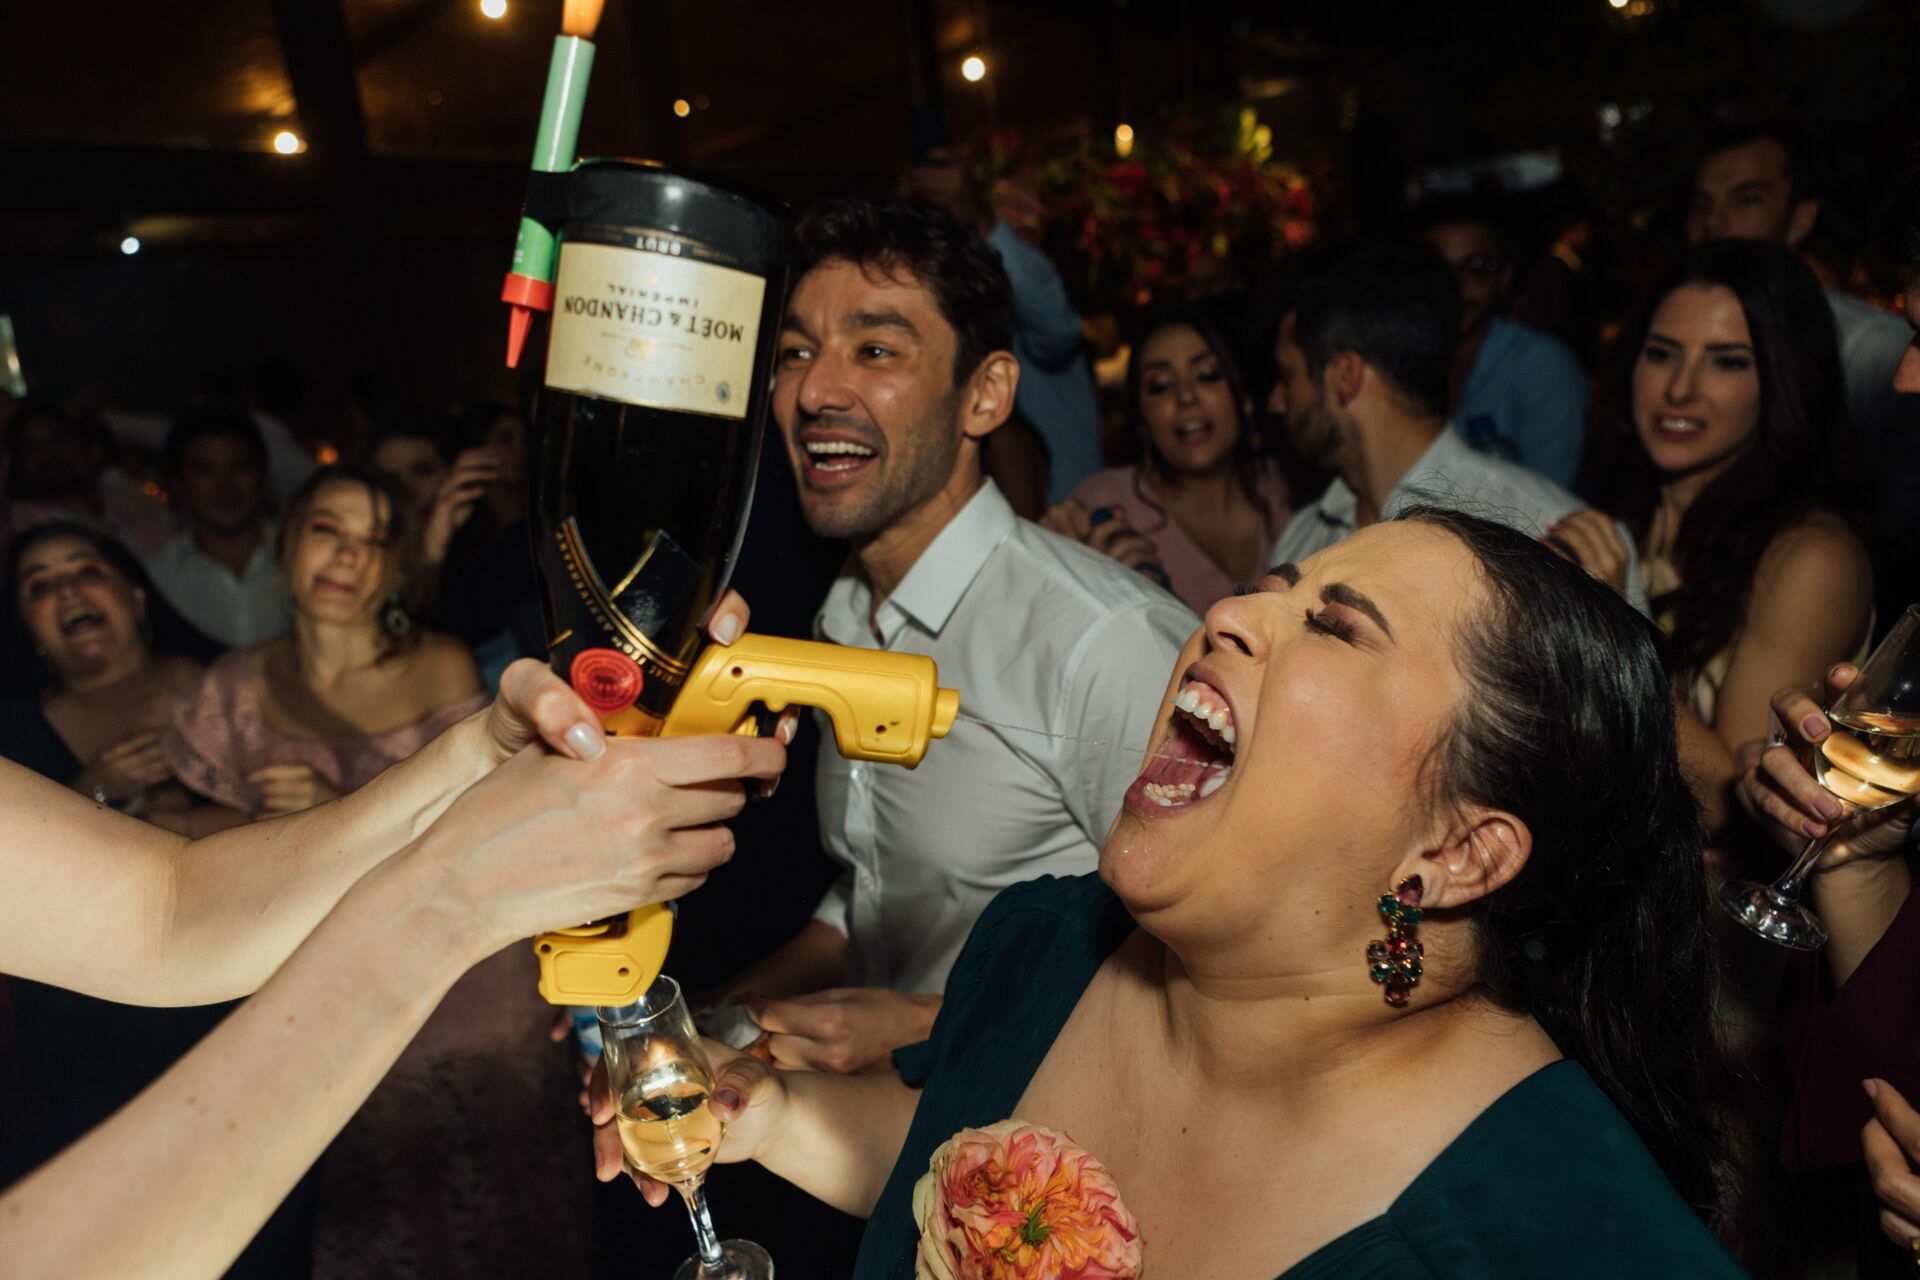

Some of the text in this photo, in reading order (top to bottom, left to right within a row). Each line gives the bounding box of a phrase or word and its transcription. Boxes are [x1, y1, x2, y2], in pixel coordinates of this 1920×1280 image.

[634, 235, 682, 256] BRUT
[564, 295, 663, 328] CHANDON
[669, 311, 682, 327] &
[582, 354, 706, 386] CHAMPAGNE
